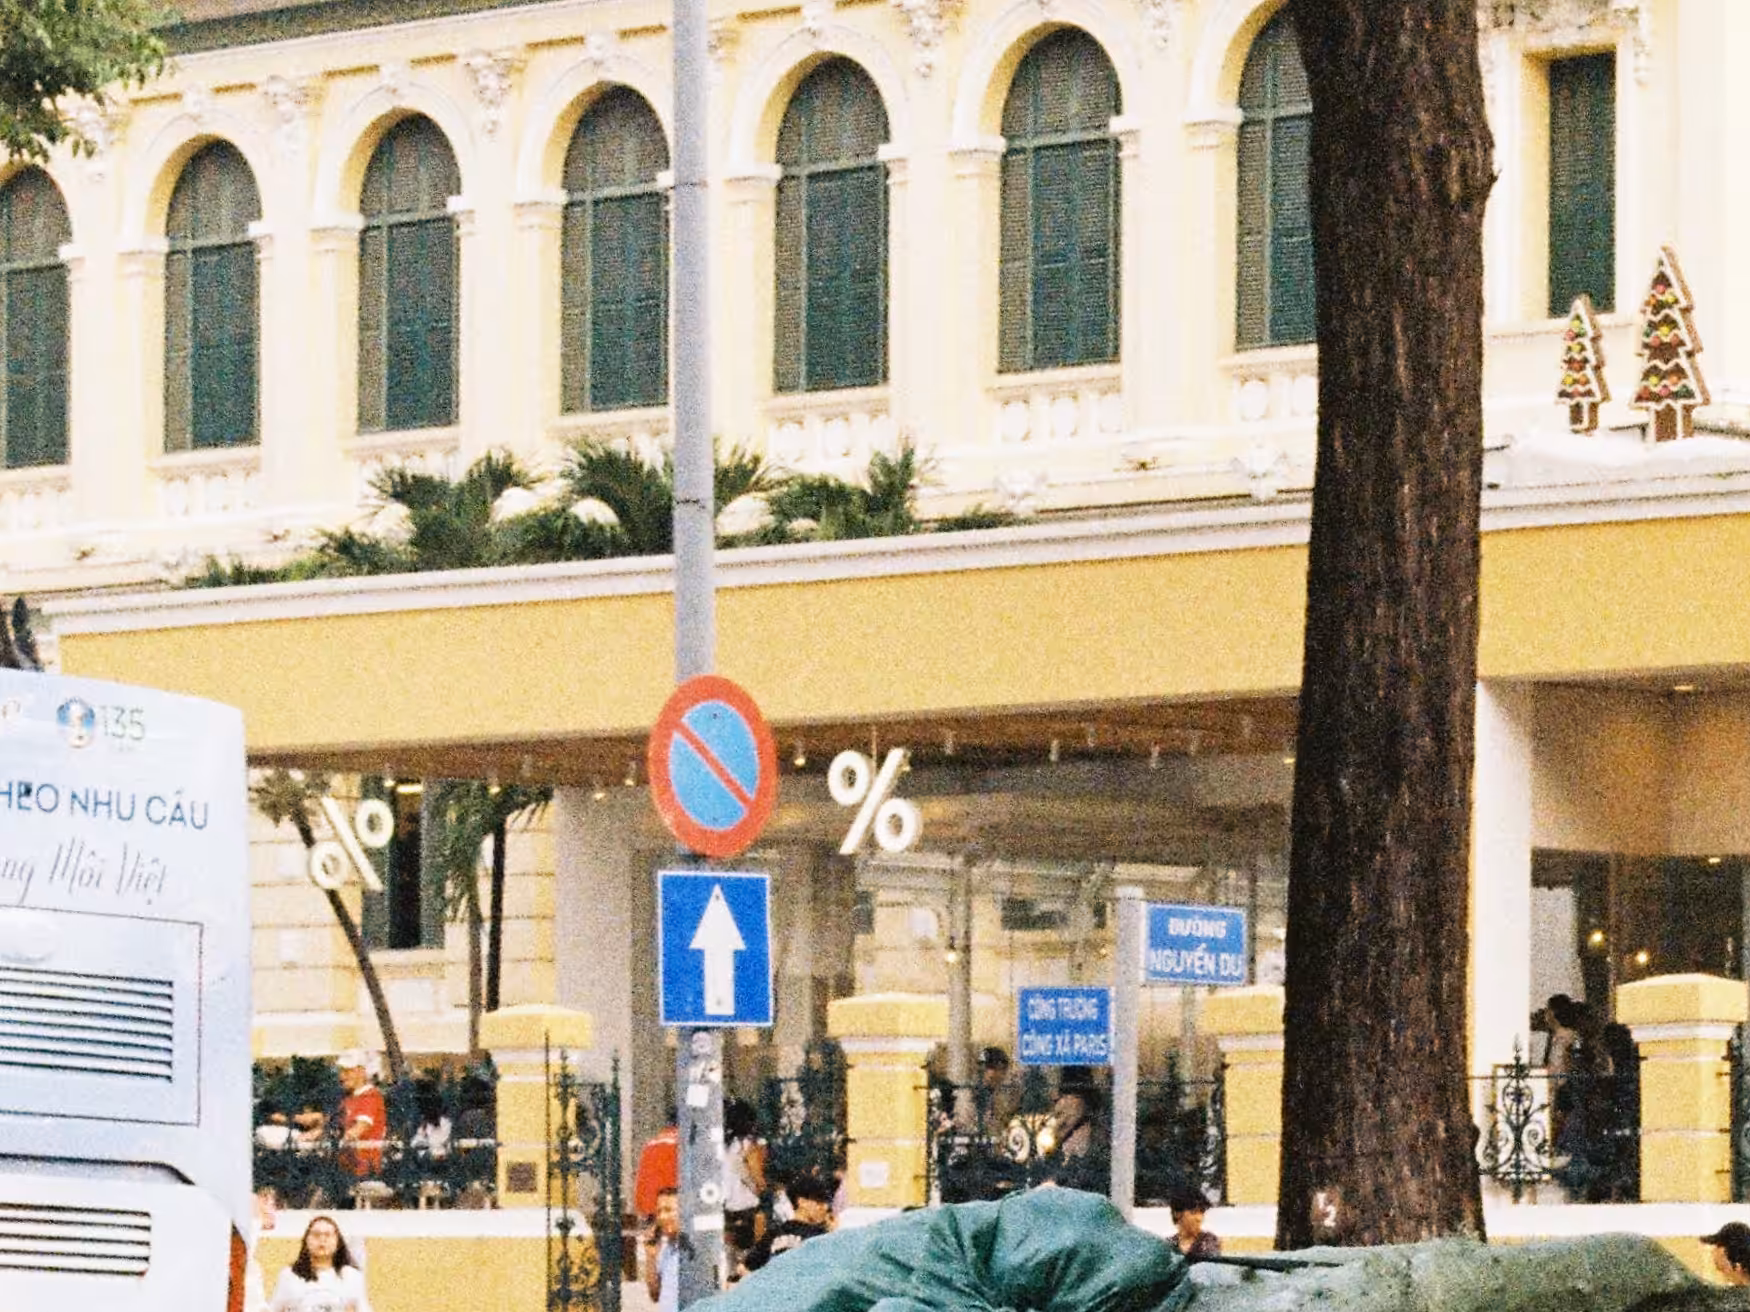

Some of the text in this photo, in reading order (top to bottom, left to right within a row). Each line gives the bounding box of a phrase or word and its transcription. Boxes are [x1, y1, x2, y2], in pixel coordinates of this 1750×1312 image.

[103, 705, 147, 742] 135
[70, 787, 136, 821] NHU
[1219, 952, 1242, 977] DU
